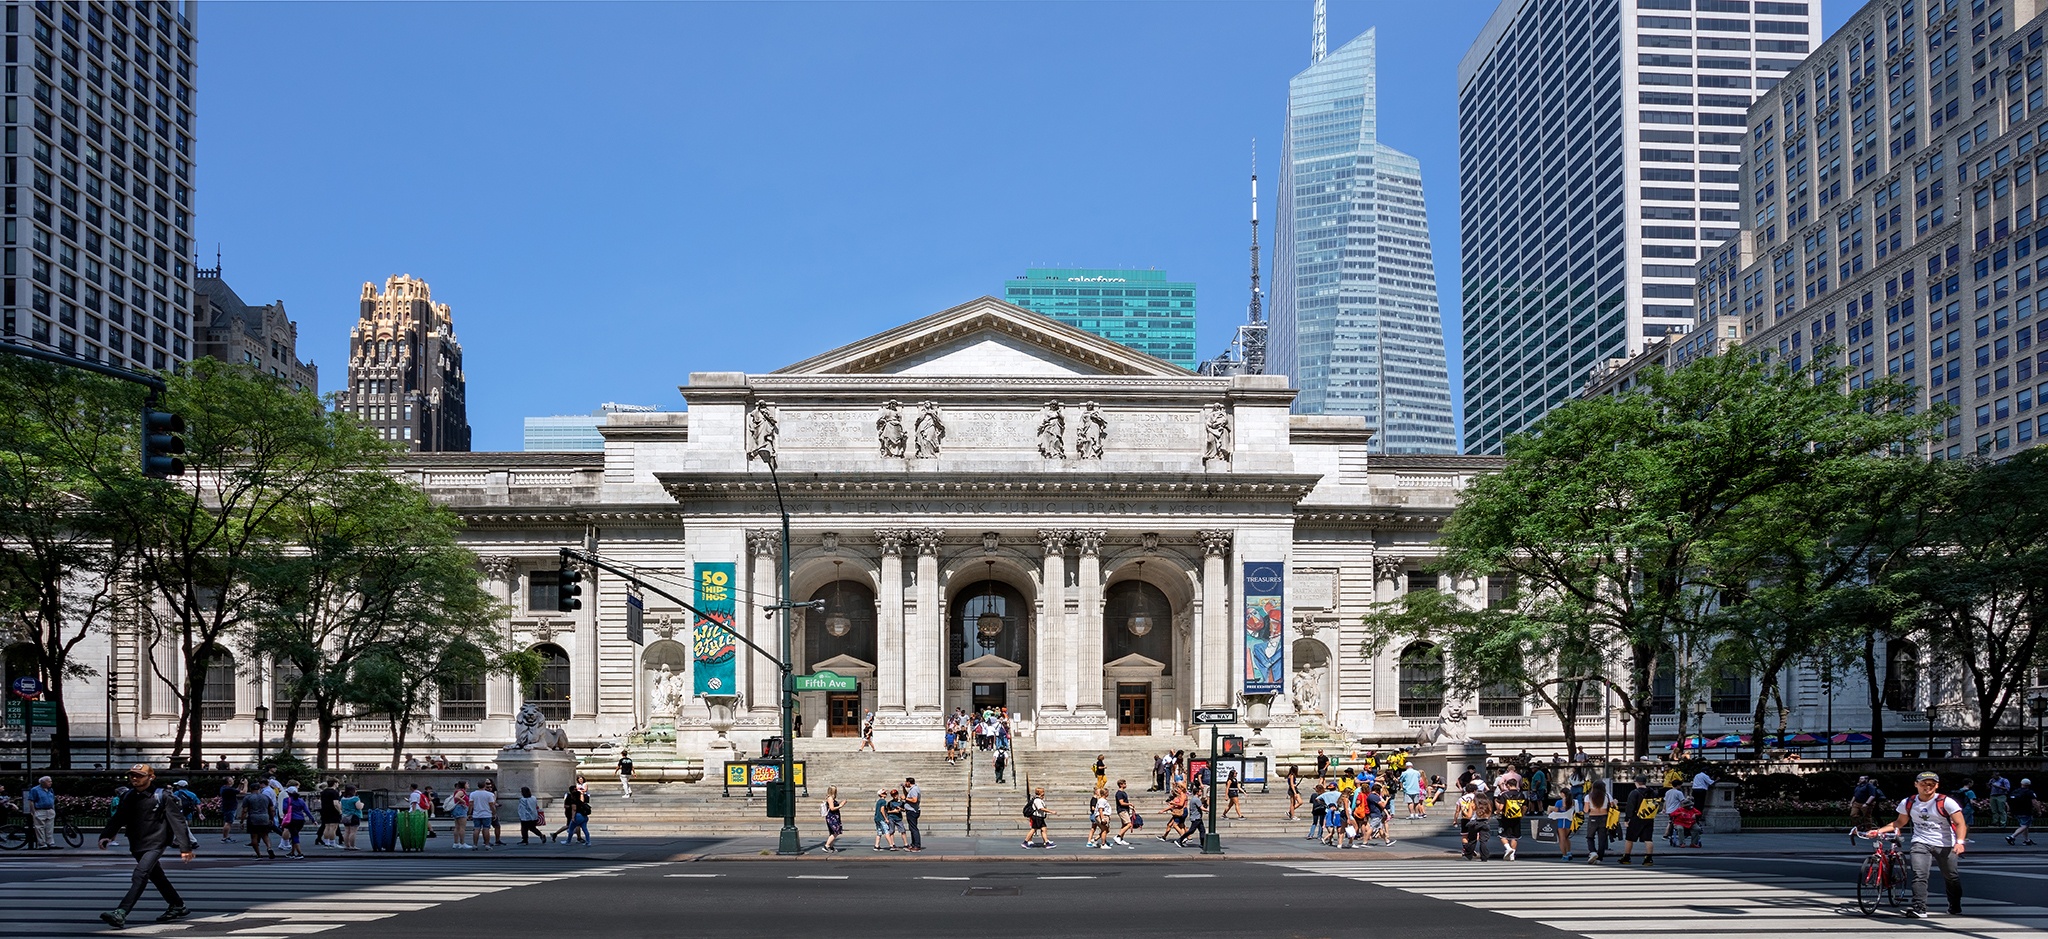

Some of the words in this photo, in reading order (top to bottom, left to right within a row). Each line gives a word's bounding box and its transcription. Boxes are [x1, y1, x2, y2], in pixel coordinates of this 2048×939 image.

[844, 503, 878, 512] THE
[890, 503, 930, 512] NEW
[945, 503, 986, 512] YORK
[1001, 503, 1056, 512] PUBLIC
[1071, 503, 1137, 512] LIBRARY
[702, 571, 728, 586] 50
[705, 593, 728, 601] HOP
[805, 679, 826, 687] Fifth
[829, 679, 847, 688] Ave
[1236, 741, 1242, 750] 4
